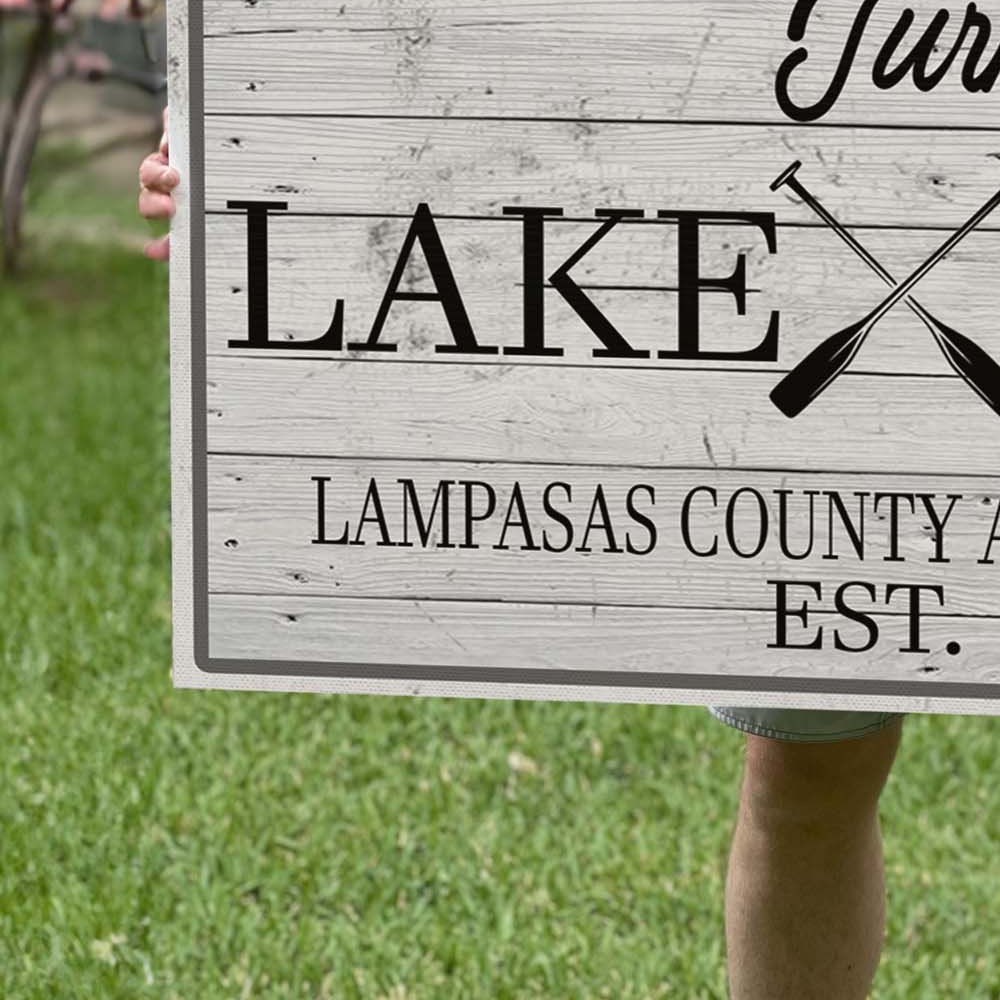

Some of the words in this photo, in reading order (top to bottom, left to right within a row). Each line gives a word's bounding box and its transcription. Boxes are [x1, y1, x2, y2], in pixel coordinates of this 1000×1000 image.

[227, 200, 780, 362] LAKE
[311, 476, 657, 556] LAMPASAS
[680, 485, 963, 563] COUNTY
[766, 579, 961, 655] EST.
